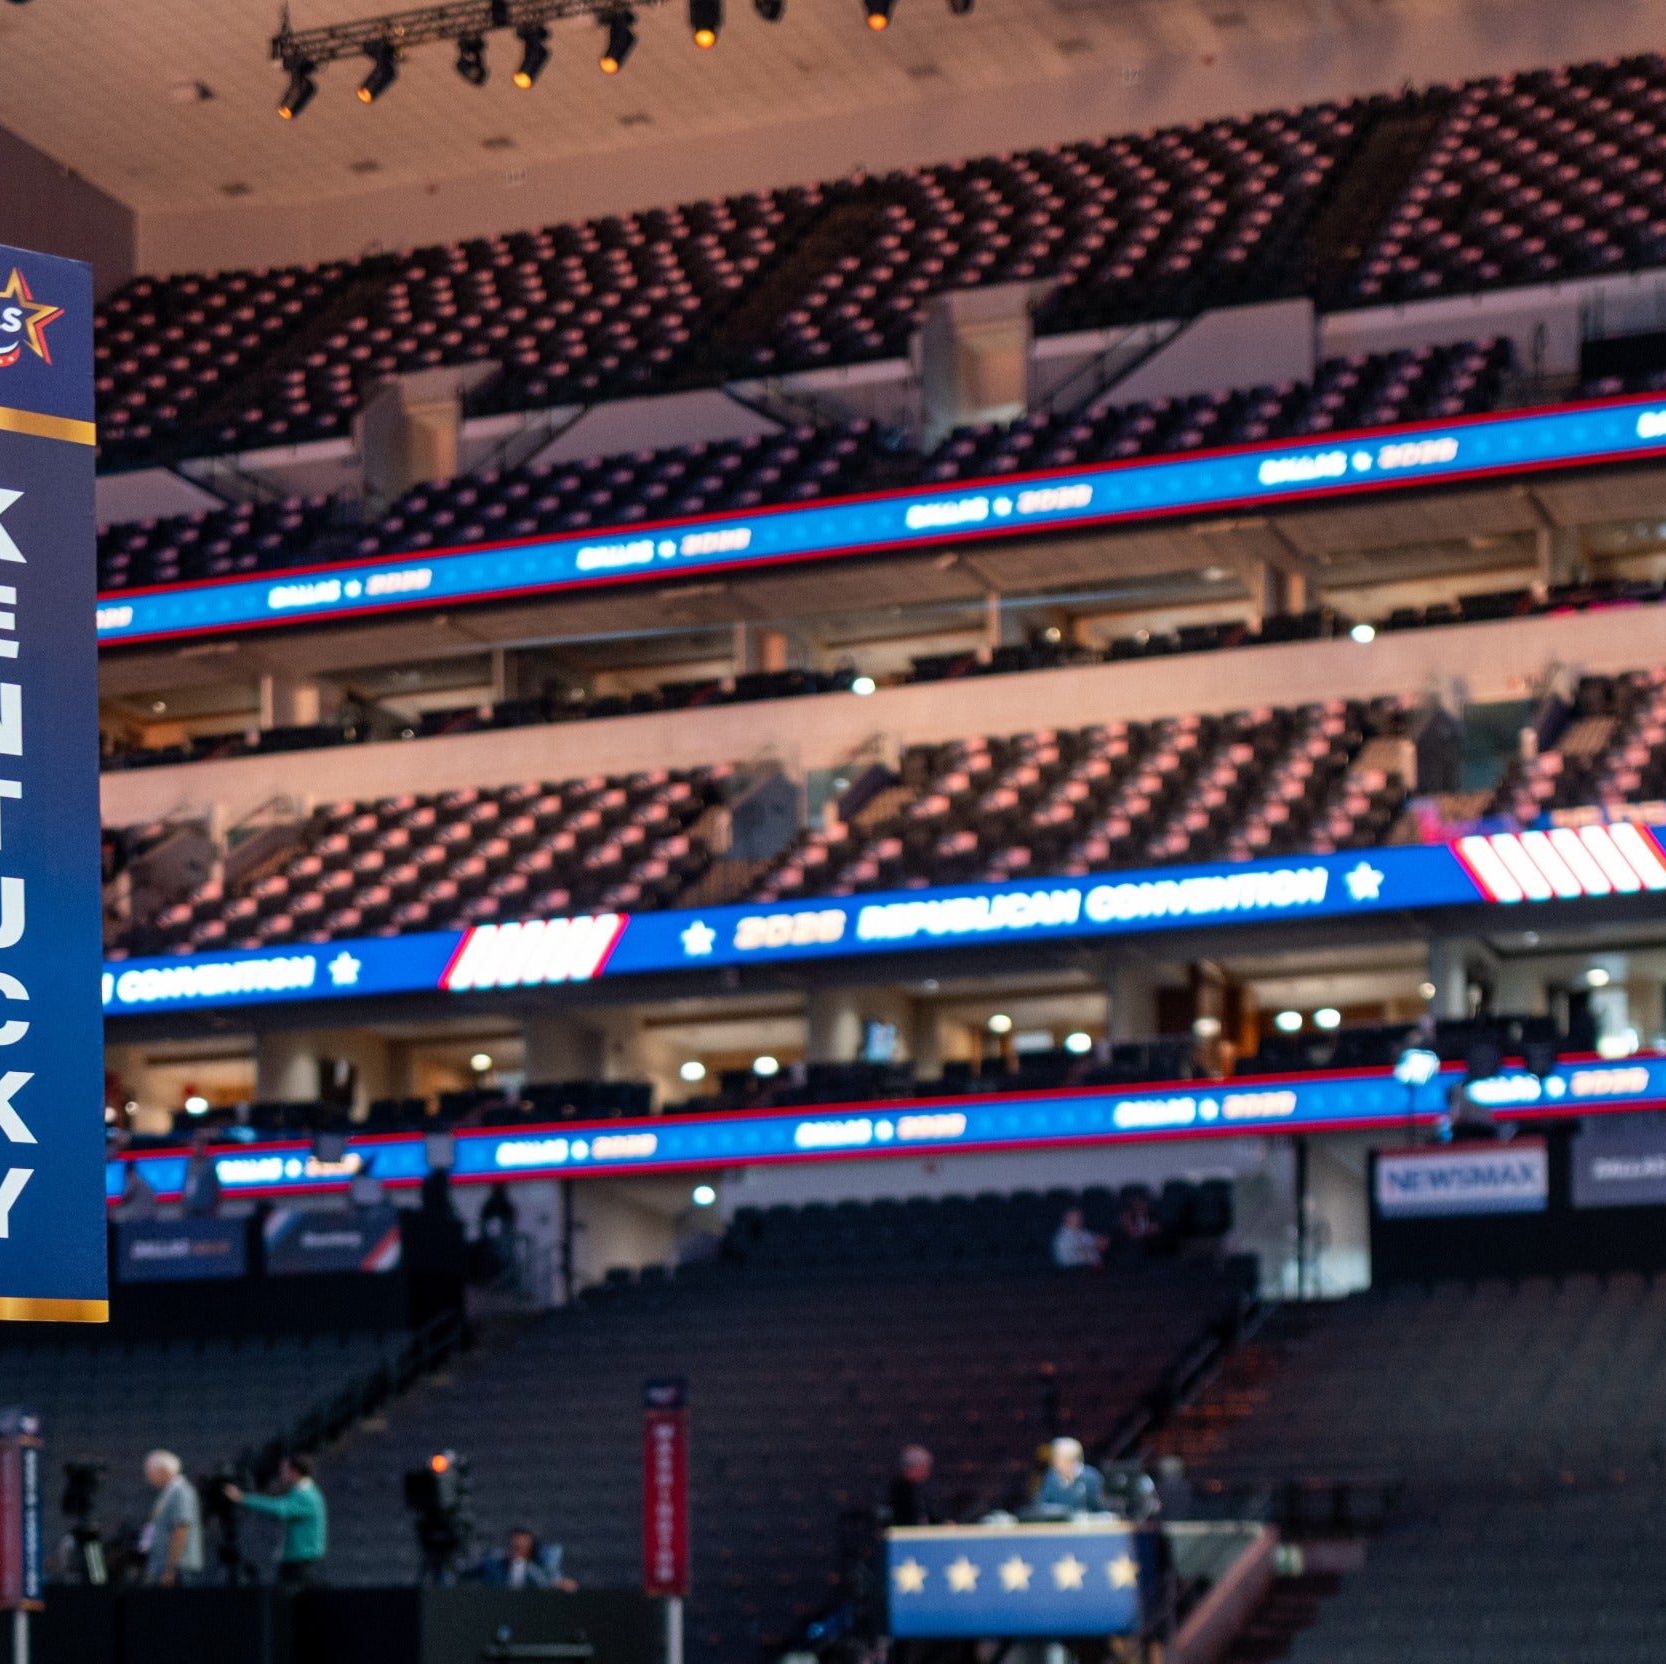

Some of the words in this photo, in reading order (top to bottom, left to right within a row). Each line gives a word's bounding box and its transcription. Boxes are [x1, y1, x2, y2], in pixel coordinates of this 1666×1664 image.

[1086, 868, 1328, 922] CONVENTION
[116, 957, 315, 1003] CONVENTION
[1387, 1159, 1533, 1192] NEWSMAX
